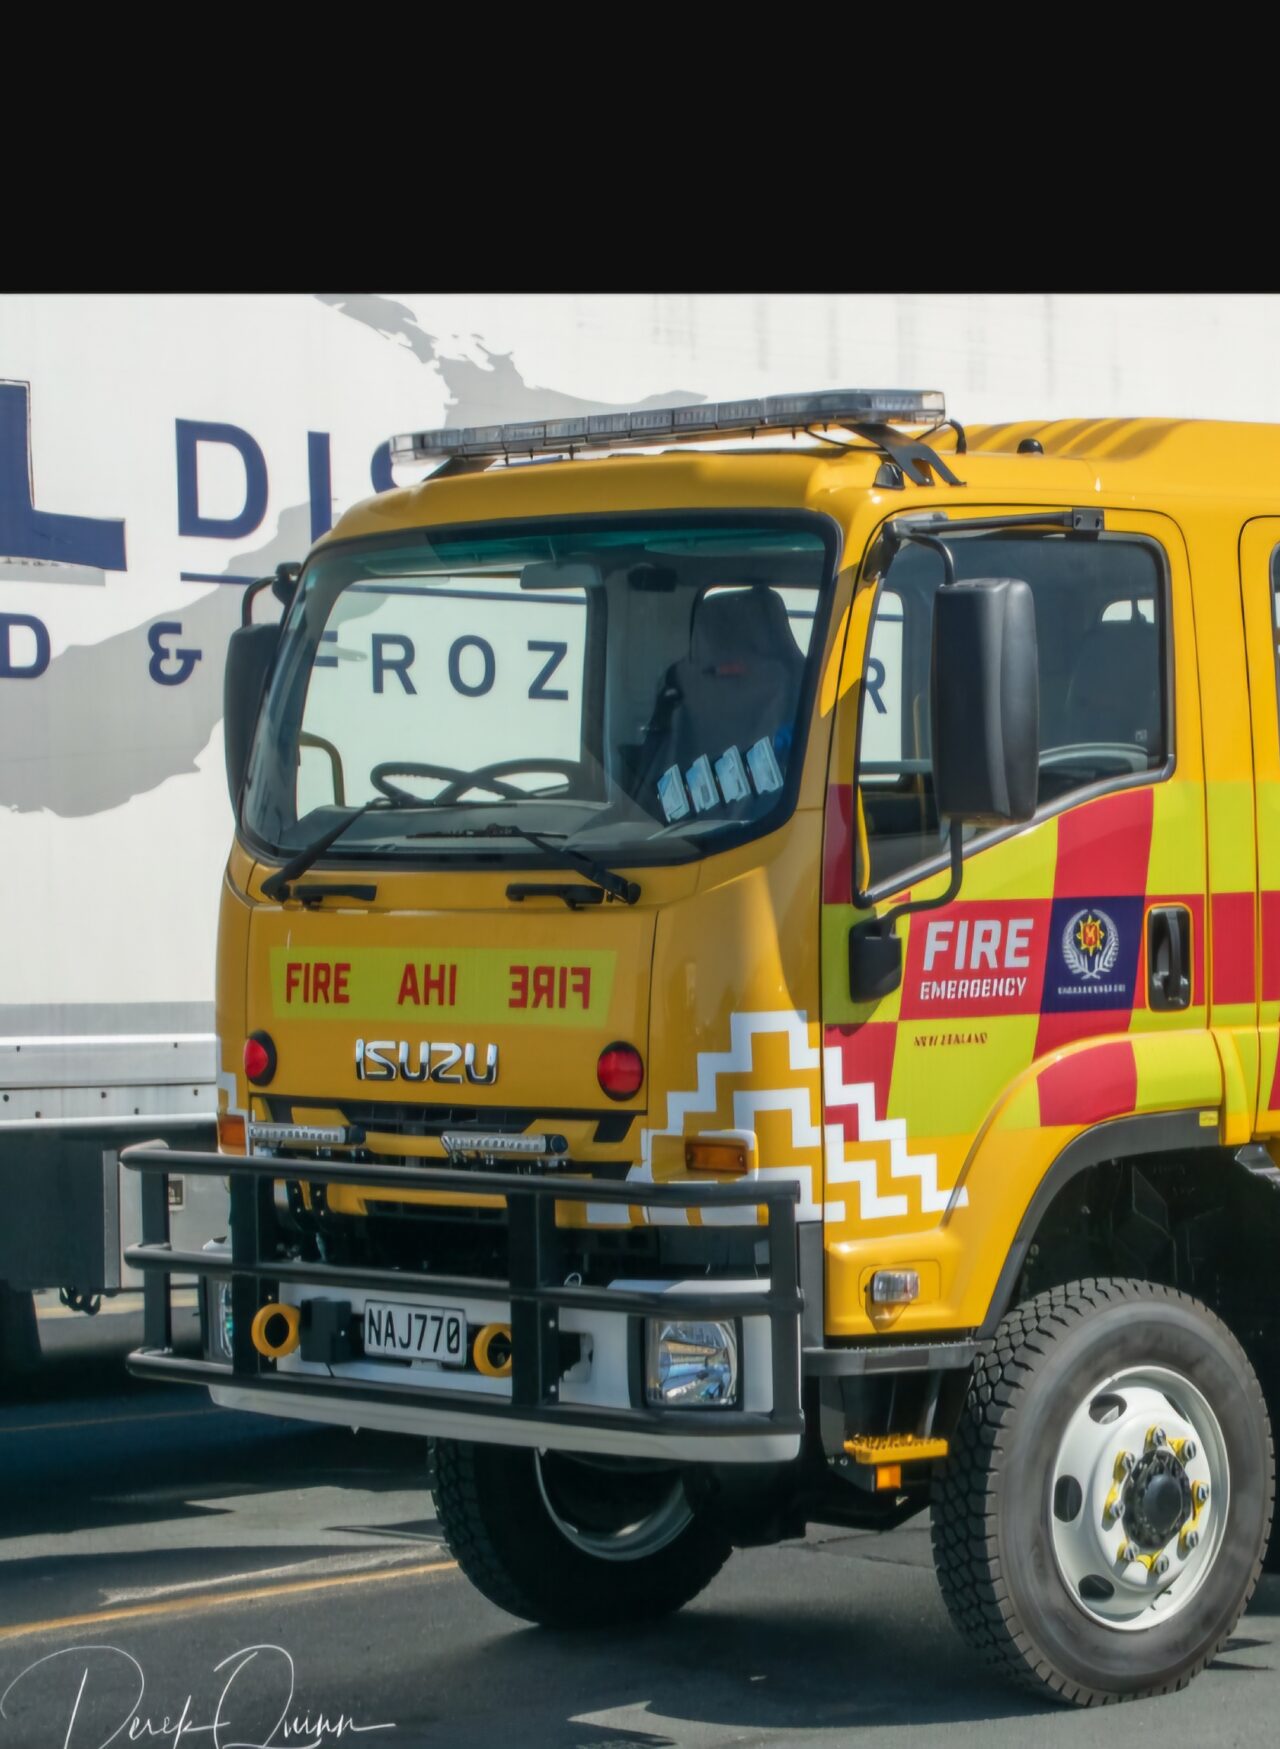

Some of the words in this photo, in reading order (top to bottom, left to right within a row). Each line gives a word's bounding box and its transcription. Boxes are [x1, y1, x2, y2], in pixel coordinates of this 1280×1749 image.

[148, 621, 202, 686] &
[922, 918, 1035, 972] FIRE
[286, 962, 351, 1004] FIRE
[397, 963, 458, 1006] AHI
[919, 977, 1027, 1000] EMERGENCY
[355, 1038, 500, 1085] ISUZU
[368, 1308, 461, 1354] NAJ770
